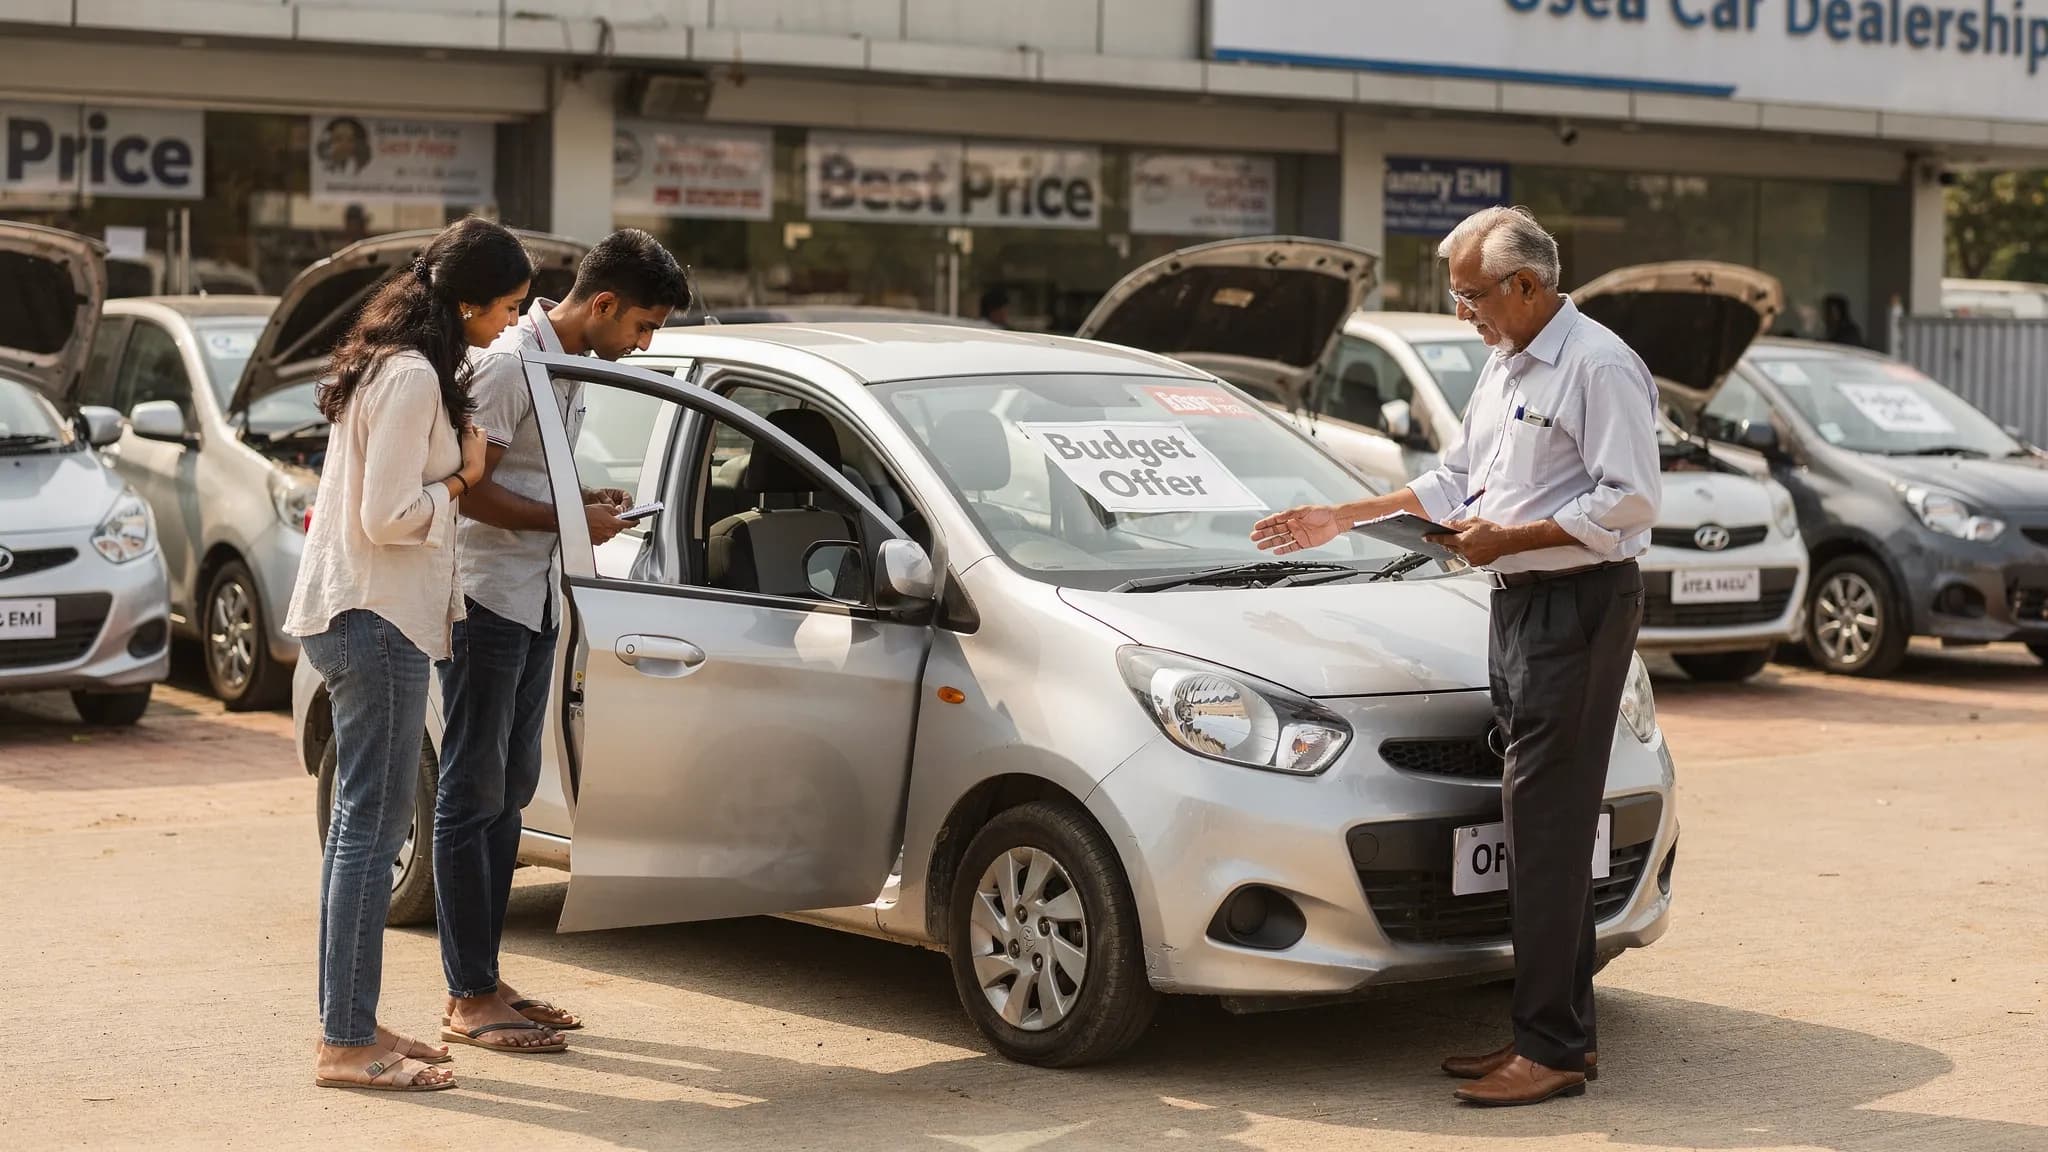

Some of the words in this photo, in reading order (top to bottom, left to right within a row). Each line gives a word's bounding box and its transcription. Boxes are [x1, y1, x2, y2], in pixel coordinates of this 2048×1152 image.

[1787, 0, 2048, 76] Dealership
[7, 111, 193, 189] Price
[819, 154, 947, 214] Best
[961, 156, 1095, 219] Price
[1043, 429, 1197, 468] Budget
[1099, 468, 1208, 498] Offer
[8, 611, 42, 627] EMI
[1472, 842, 1505, 875] OF
